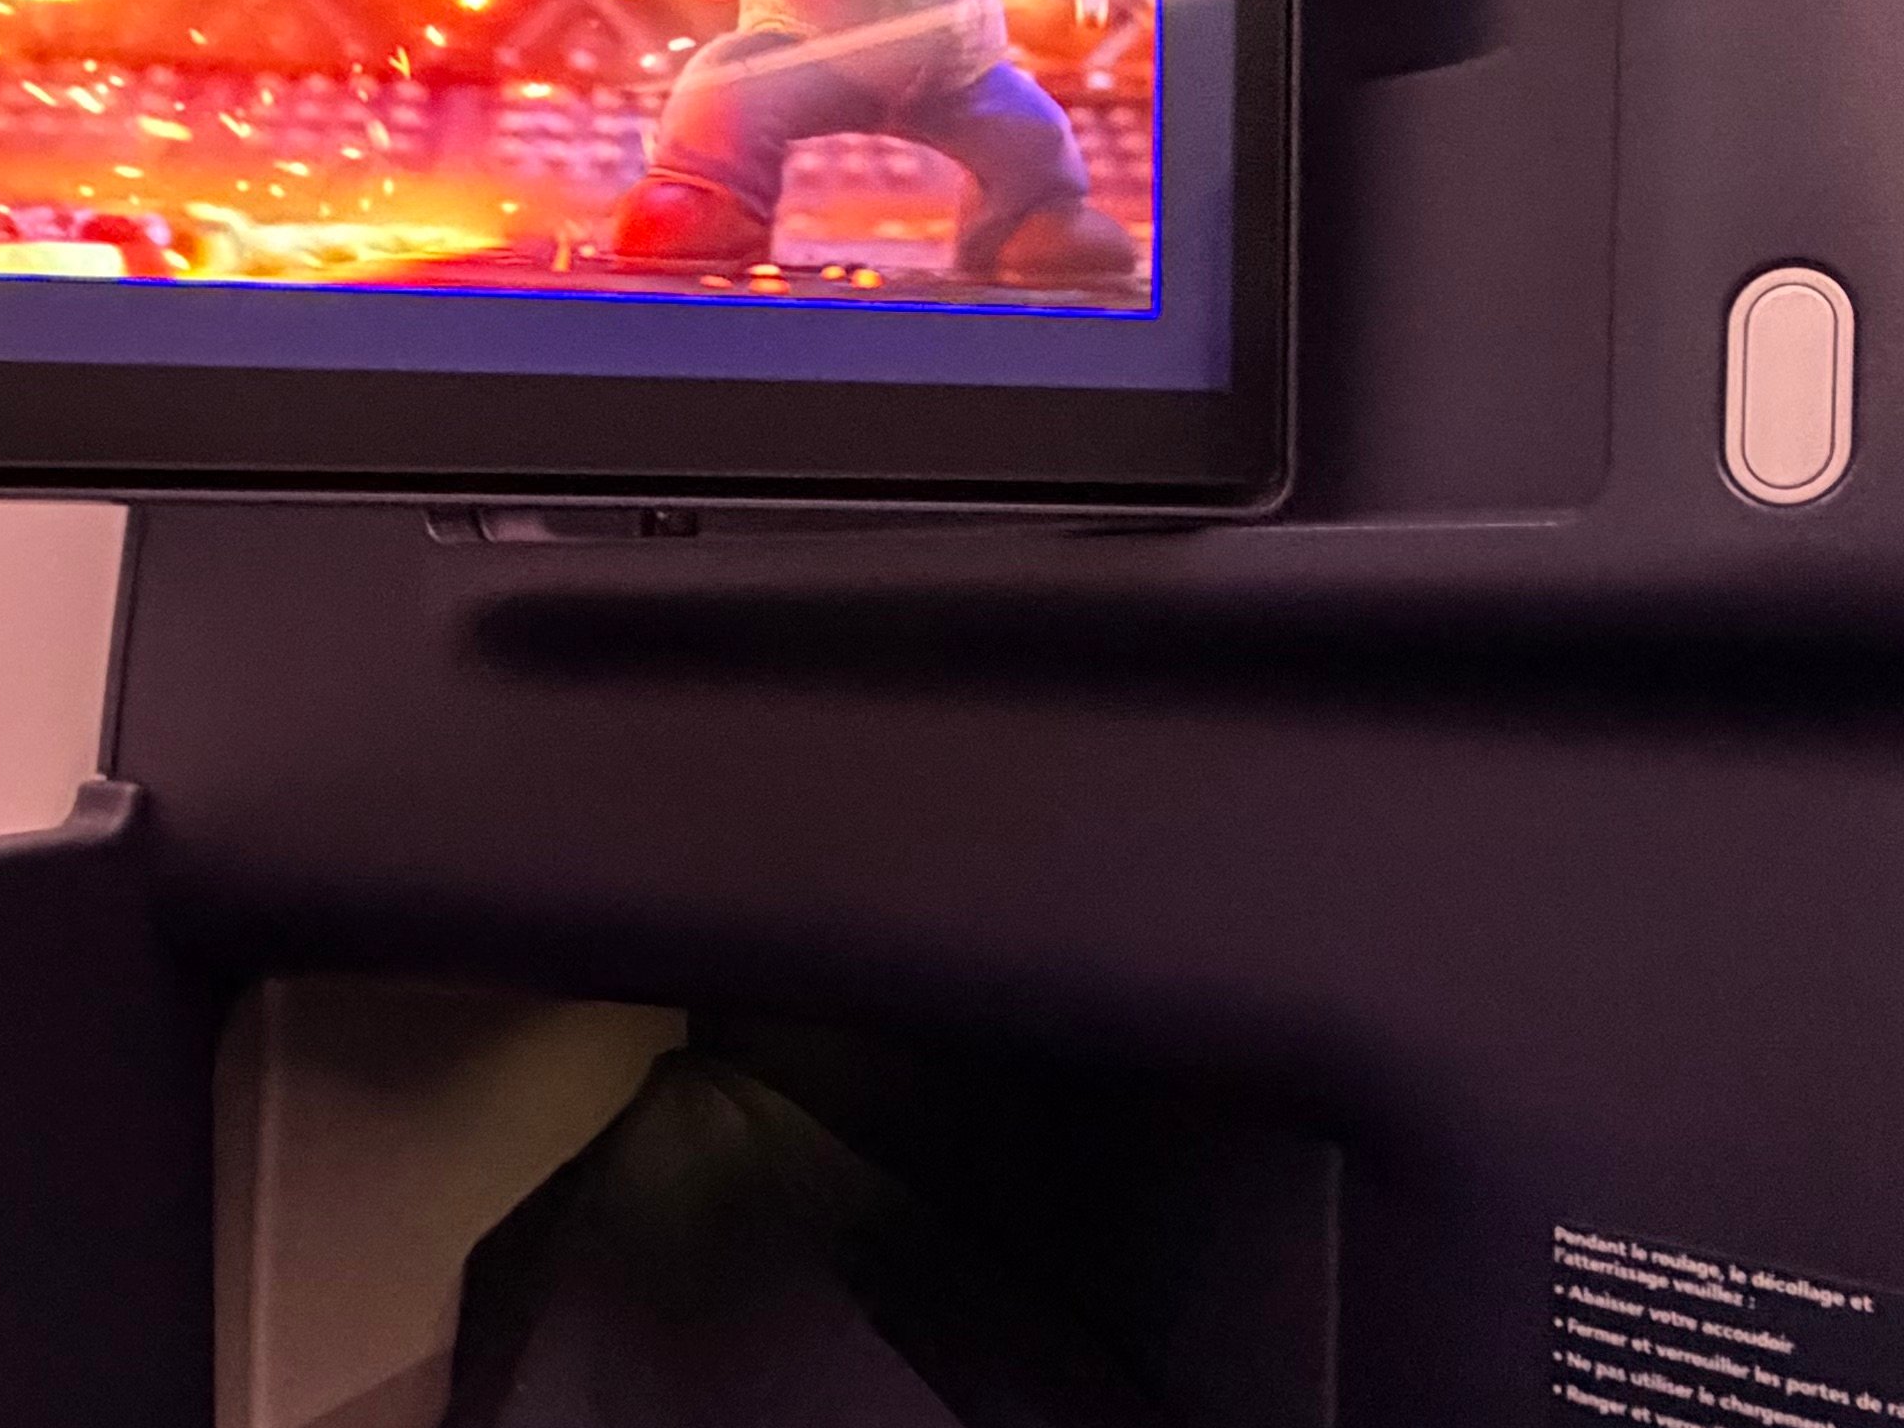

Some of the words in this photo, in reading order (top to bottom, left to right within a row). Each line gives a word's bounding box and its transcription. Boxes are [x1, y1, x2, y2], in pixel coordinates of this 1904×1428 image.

[1554, 1225, 1627, 1256] Pendant
[1631, 1243, 1647, 1261] le
[1651, 1252, 1725, 1282] roulage,
[1729, 1264, 1746, 1284] le
[1751, 1271, 1845, 1308] décollage
[1850, 1296, 1874, 1313] et
[1673, 1279, 1744, 1307] veuillez
[1568, 1285, 1645, 1317] Abaisser
[1649, 1308, 1697, 1331] votre
[1702, 1322, 1795, 1354] accoudoir
[1567, 1317, 1629, 1348] Fermer
[1631, 1337, 1652, 1354] et
[1655, 1344, 1750, 1379] verrouiller
[1754, 1365, 1781, 1388] les
[1785, 1377, 1850, 1405] portes
[1855, 1391, 1882, 1414] de
[1567, 1351, 1591, 1372] Ne
[1596, 1362, 1627, 1382] pas
[1630, 1373, 1694, 1399] utiliser
[1698, 1386, 1715, 1407] le
[1567, 1385, 1627, 1415] Ranger
[1631, 1408, 1651, 1424] et
